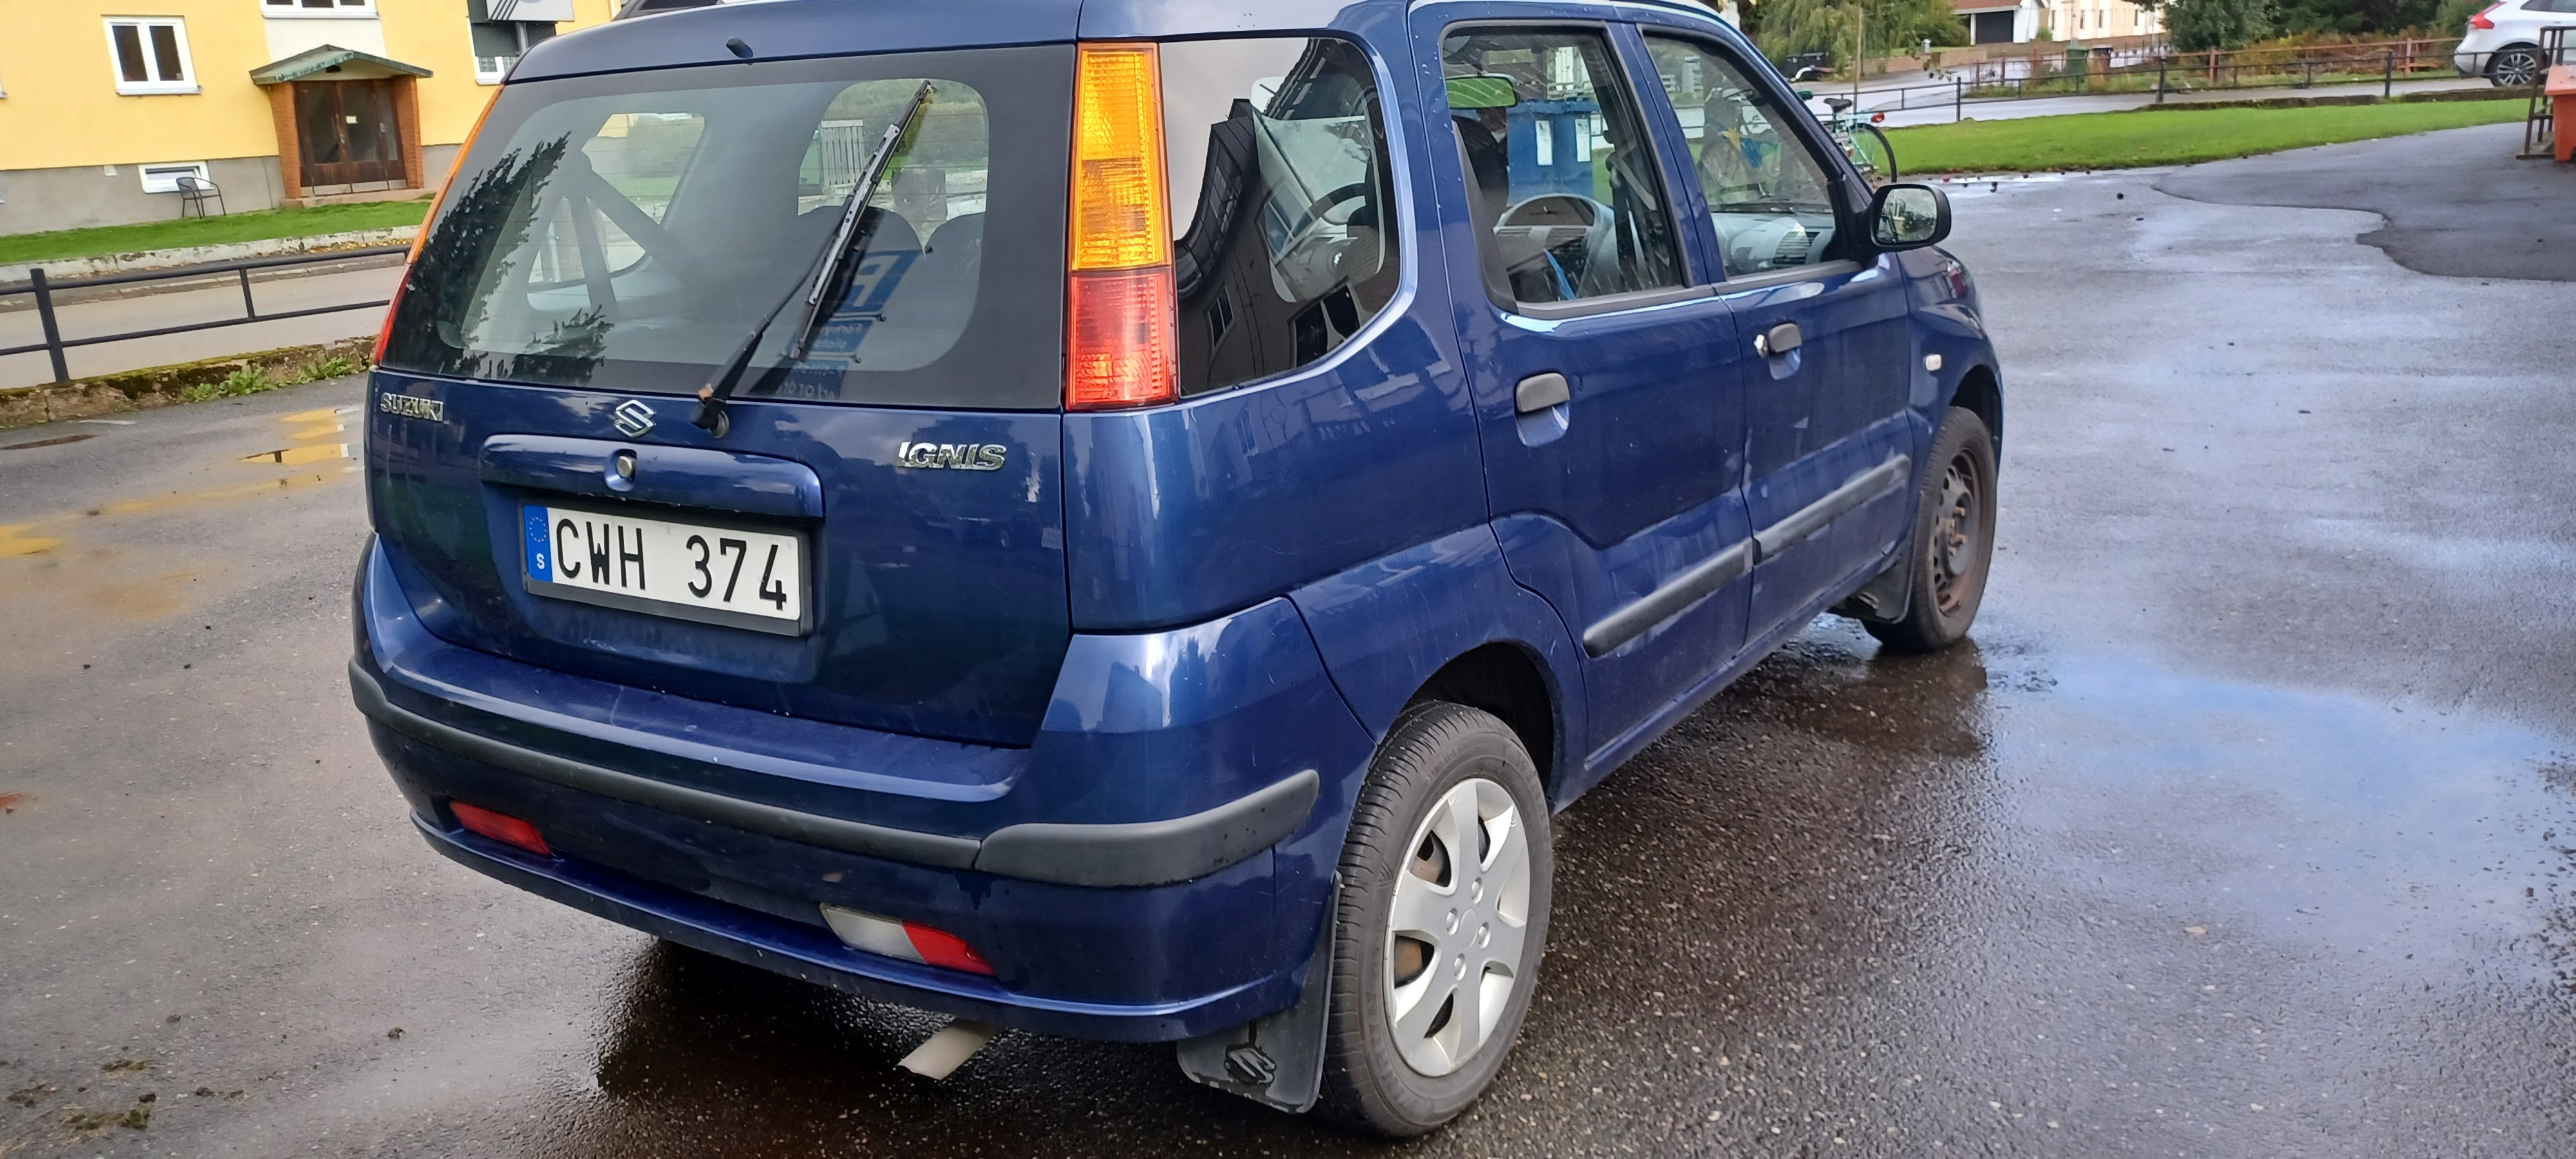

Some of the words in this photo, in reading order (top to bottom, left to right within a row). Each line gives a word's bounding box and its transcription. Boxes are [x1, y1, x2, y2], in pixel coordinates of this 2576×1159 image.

[381, 392, 444, 422] SUZUKI
[897, 441, 1007, 471] IGNIS
[536, 552, 545, 570] S
[556, 518, 646, 591] CWH
[686, 534, 787, 611] 374
